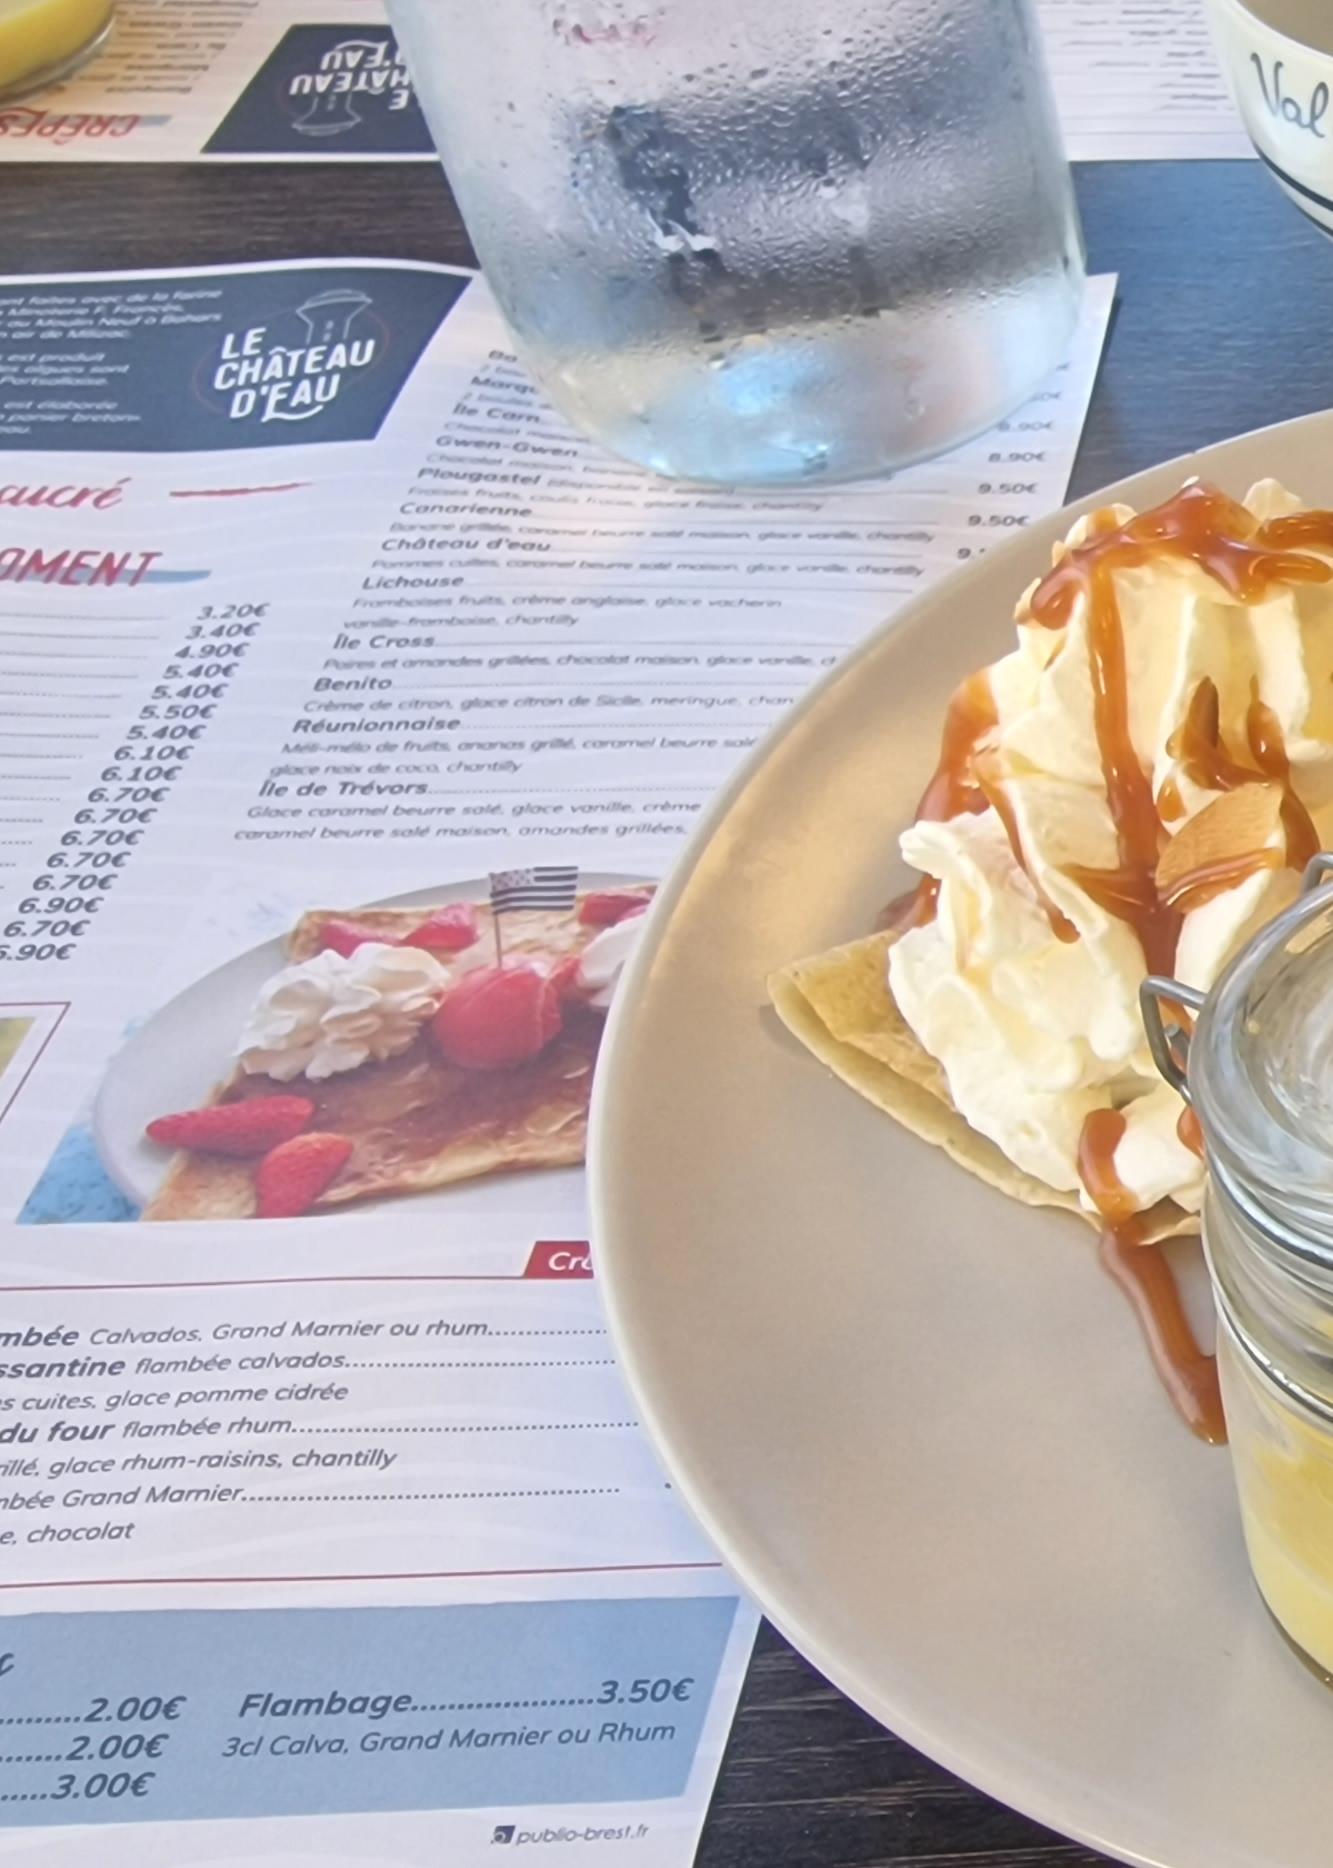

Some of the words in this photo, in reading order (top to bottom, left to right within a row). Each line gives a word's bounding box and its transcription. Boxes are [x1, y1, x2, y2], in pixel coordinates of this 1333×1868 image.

[289, 69, 410, 95] HÂTEAU
[388, 89, 409, 110] E
[1250, 52, 1329, 138] Val
[221, 327, 267, 360] LE
[214, 339, 376, 390] CHÂTEAU
[230, 373, 341, 423] D'EAU
[417, 467, 541, 486] Plougastel
[399, 501, 533, 518] Canarienne
[381, 537, 479, 552] Château
[486, 537, 551, 553] d'eau
[361, 576, 464, 591] Lichouse
[196, 602, 270, 621] 3.20€
[185, 622, 260, 640] 3.40€
[174, 642, 250, 659] 4.90€
[369, 635, 435, 650] Cross
[162, 662, 240, 680] 5.40€
[150, 683, 229, 700] 5.40€
[313, 676, 393, 693] Benito
[138, 703, 218, 720] 5.50€
[125, 724, 207, 741] 5.40€
[292, 716, 462, 734] Réunionnaise
[113, 745, 195, 761] 6.10€
[100, 766, 183, 782] 6.10€
[87, 786, 171, 803] 6.70€
[258, 779, 289, 798] Île
[296, 781, 327, 797] de
[338, 780, 428, 797] Trévors
[74, 808, 158, 824] 6.70€
[247, 805, 302, 819] Glace
[308, 803, 388, 818] caramel
[392, 803, 455, 817] beurre
[511, 802, 564, 818] glace
[642, 800, 701, 813] crème
[60, 829, 145, 846] 6.70€
[233, 826, 316, 841] caramel
[319, 826, 384, 840] beurre
[518, 822, 609, 837] amandes
[46, 851, 132, 868] 6.70€
[32, 873, 118, 891] 6.70€
[18, 896, 104, 914] 6.90€
[3, 919, 91, 937] 6.70€
[212, 1321, 287, 1340] Grand
[291, 1320, 384, 1337] Marnier
[389, 1322, 419, 1336] ou
[135, 1354, 232, 1374] flambée
[104, 1390, 171, 1411] glace
[174, 1387, 268, 1407] pomme
[274, 1382, 349, 1401] cidrée
[0, 1422, 38, 1444] du
[47, 1420, 115, 1442] four
[122, 1417, 221, 1438] flambée
[47, 1456, 116, 1480] glace
[121, 1450, 283, 1471] rhum-raisins,
[292, 1449, 397, 1470] chantilly
[62, 1486, 141, 1508] Grand
[145, 1484, 243, 1503] Marnier
[27, 1522, 135, 1543] chocolat
[238, 1690, 413, 1720] Flambage
[596, 1677, 694, 1704] 3.50€
[83, 1695, 187, 1723] 2.00€
[65, 1733, 169, 1761] 2.00€
[221, 1736, 262, 1758] 3cl
[269, 1734, 348, 1758] Calva,
[359, 1728, 443, 1753] Grand
[448, 1726, 552, 1750] Marnier
[557, 1727, 591, 1745] ou
[598, 1721, 675, 1744] Rhum
[50, 1772, 156, 1799] 3.00€
